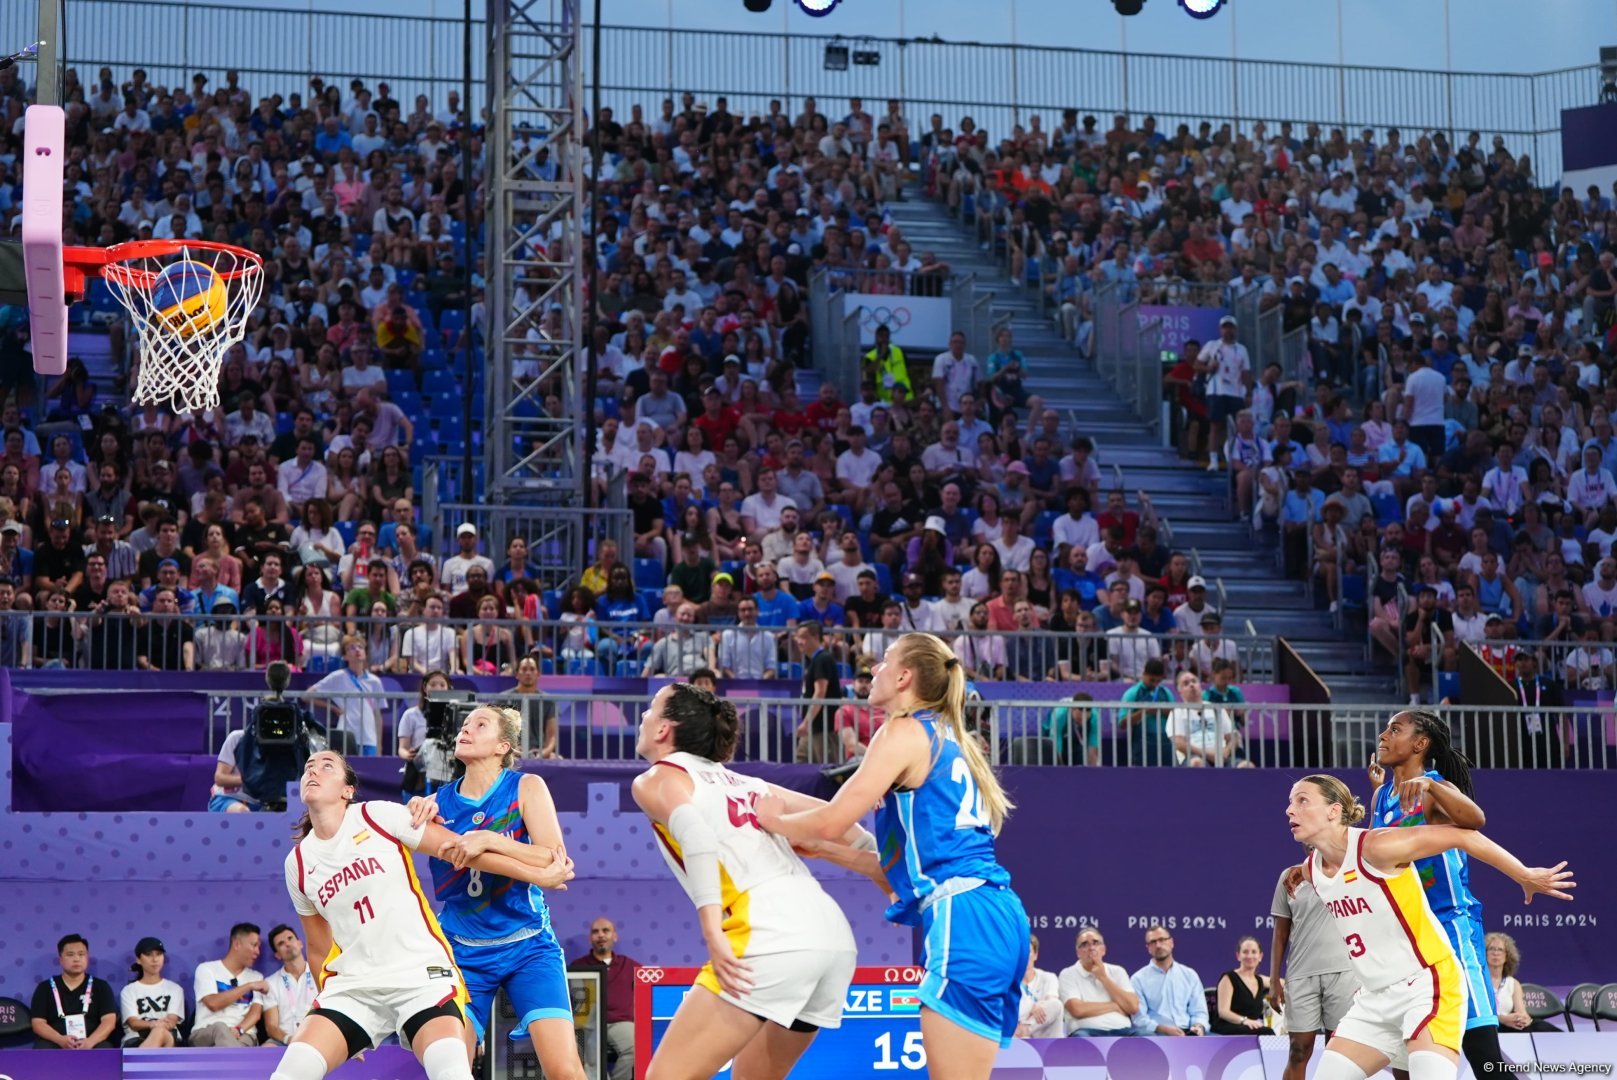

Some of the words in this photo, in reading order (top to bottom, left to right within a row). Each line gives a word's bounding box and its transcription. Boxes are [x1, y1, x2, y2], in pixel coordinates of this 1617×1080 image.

[318, 857, 385, 908] ESPAÑA
[467, 866, 483, 897] 8
[353, 895, 375, 924] 11
[1054, 915, 1099, 928] 2024
[1128, 916, 1176, 928] PARIS
[1182, 916, 1226, 928] 2024
[1503, 914, 1550, 927] PARIS
[1555, 914, 1597, 927] 2024
[1343, 933, 1367, 960] 3
[0, 1015, 15, 1024] 24
[873, 1031, 927, 1070] 15
